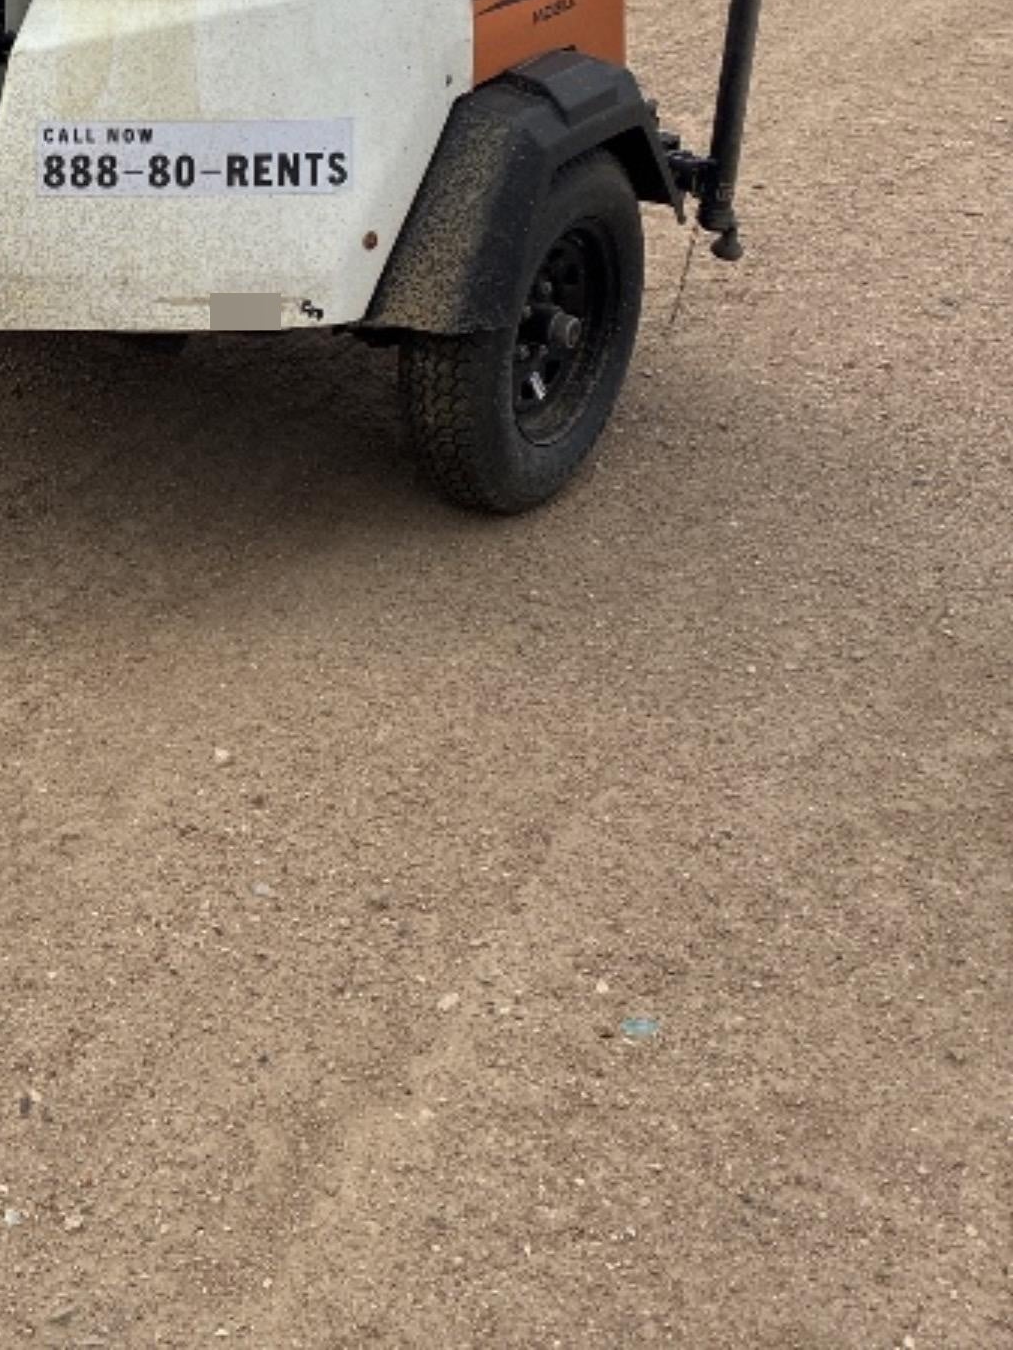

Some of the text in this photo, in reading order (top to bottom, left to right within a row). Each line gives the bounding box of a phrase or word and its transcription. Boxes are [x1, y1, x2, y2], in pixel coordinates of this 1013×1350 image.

[43, 127, 154, 145] CALL NOW
[43, 152, 348, 189] 888-80-RENTS
